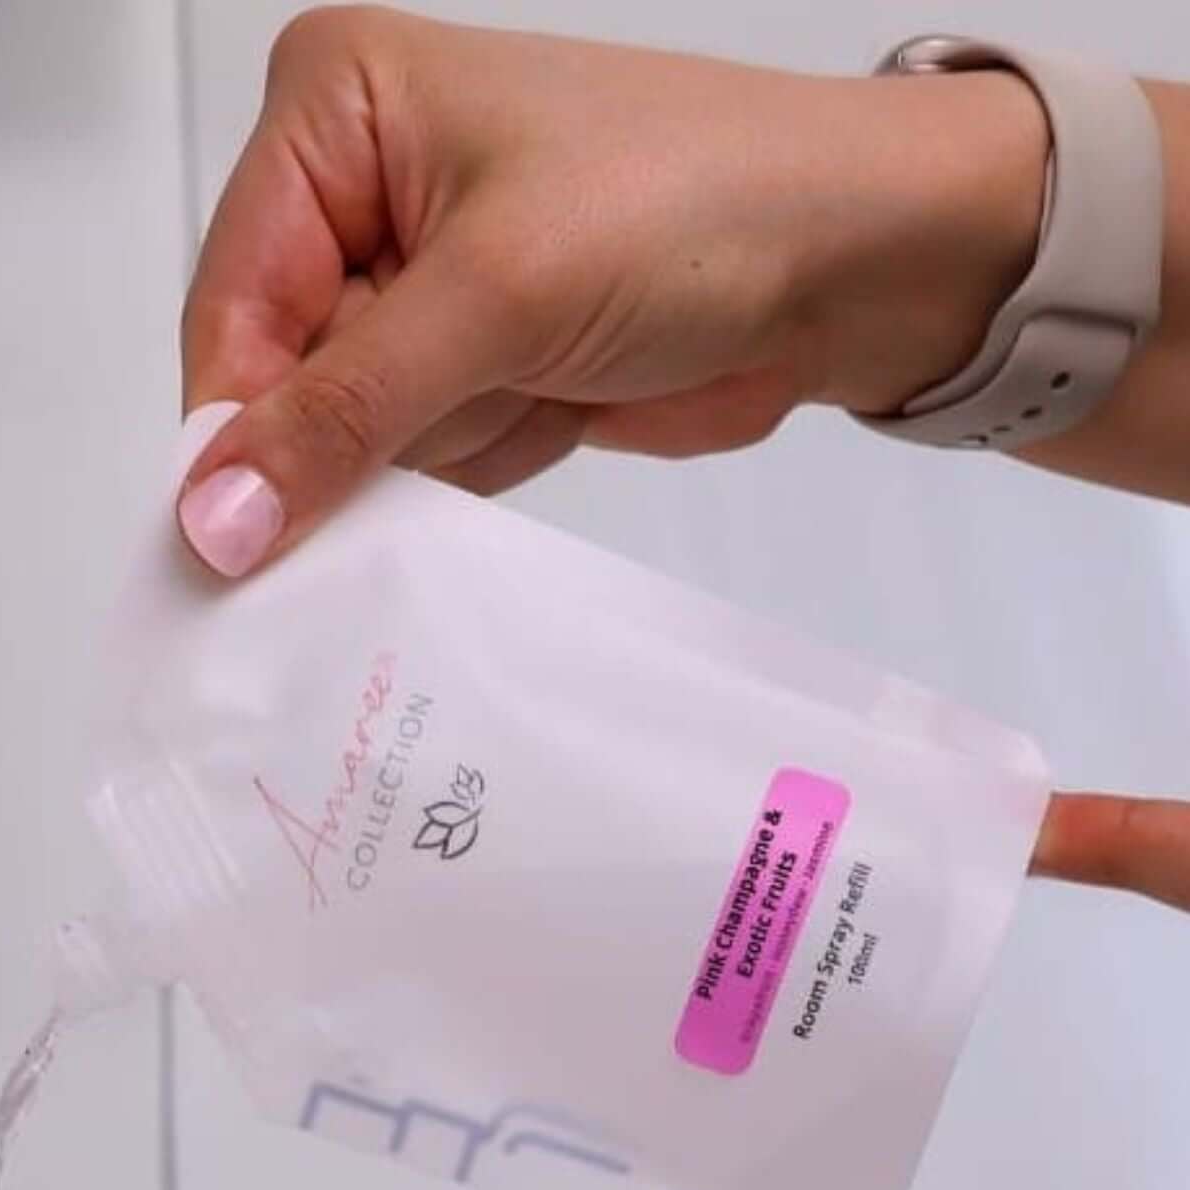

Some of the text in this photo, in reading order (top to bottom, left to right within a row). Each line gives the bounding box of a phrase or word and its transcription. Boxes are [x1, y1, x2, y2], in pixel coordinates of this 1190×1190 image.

[347, 692, 433, 891] COLLECTION
[696, 952, 726, 1001] Pink
[716, 828, 775, 951] Champagne
[763, 809, 783, 826] &
[737, 913, 772, 979] Exotic
[761, 851, 798, 911] Fruits
[793, 862, 873, 1040] Room Spray Refill
[848, 933, 878, 985] 100ml
